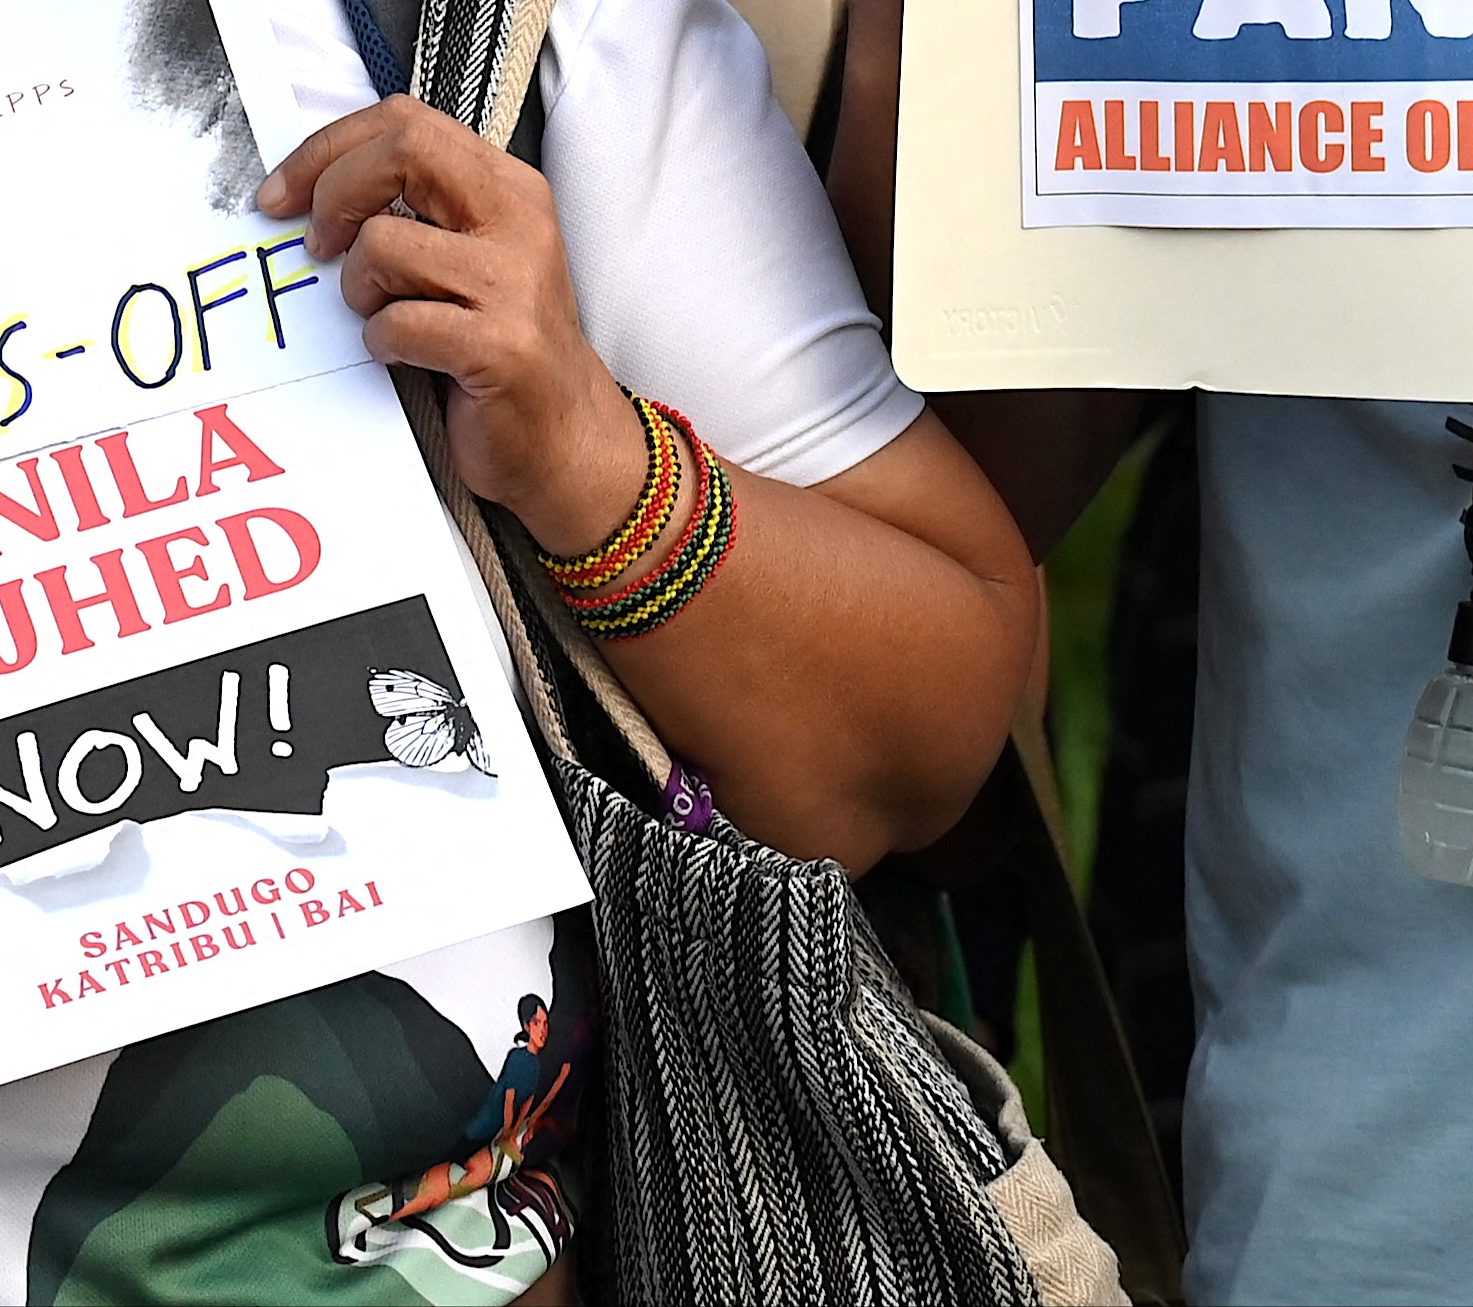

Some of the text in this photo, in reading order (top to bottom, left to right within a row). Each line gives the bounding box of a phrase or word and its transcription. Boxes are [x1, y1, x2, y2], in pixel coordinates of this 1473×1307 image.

[1055, 100, 1386, 174] ALLIANCE
[37, 920, 257, 1010] KATRIBU
[299, 880, 385, 929] BAI
[79, 867, 316, 959] SANDUGO
